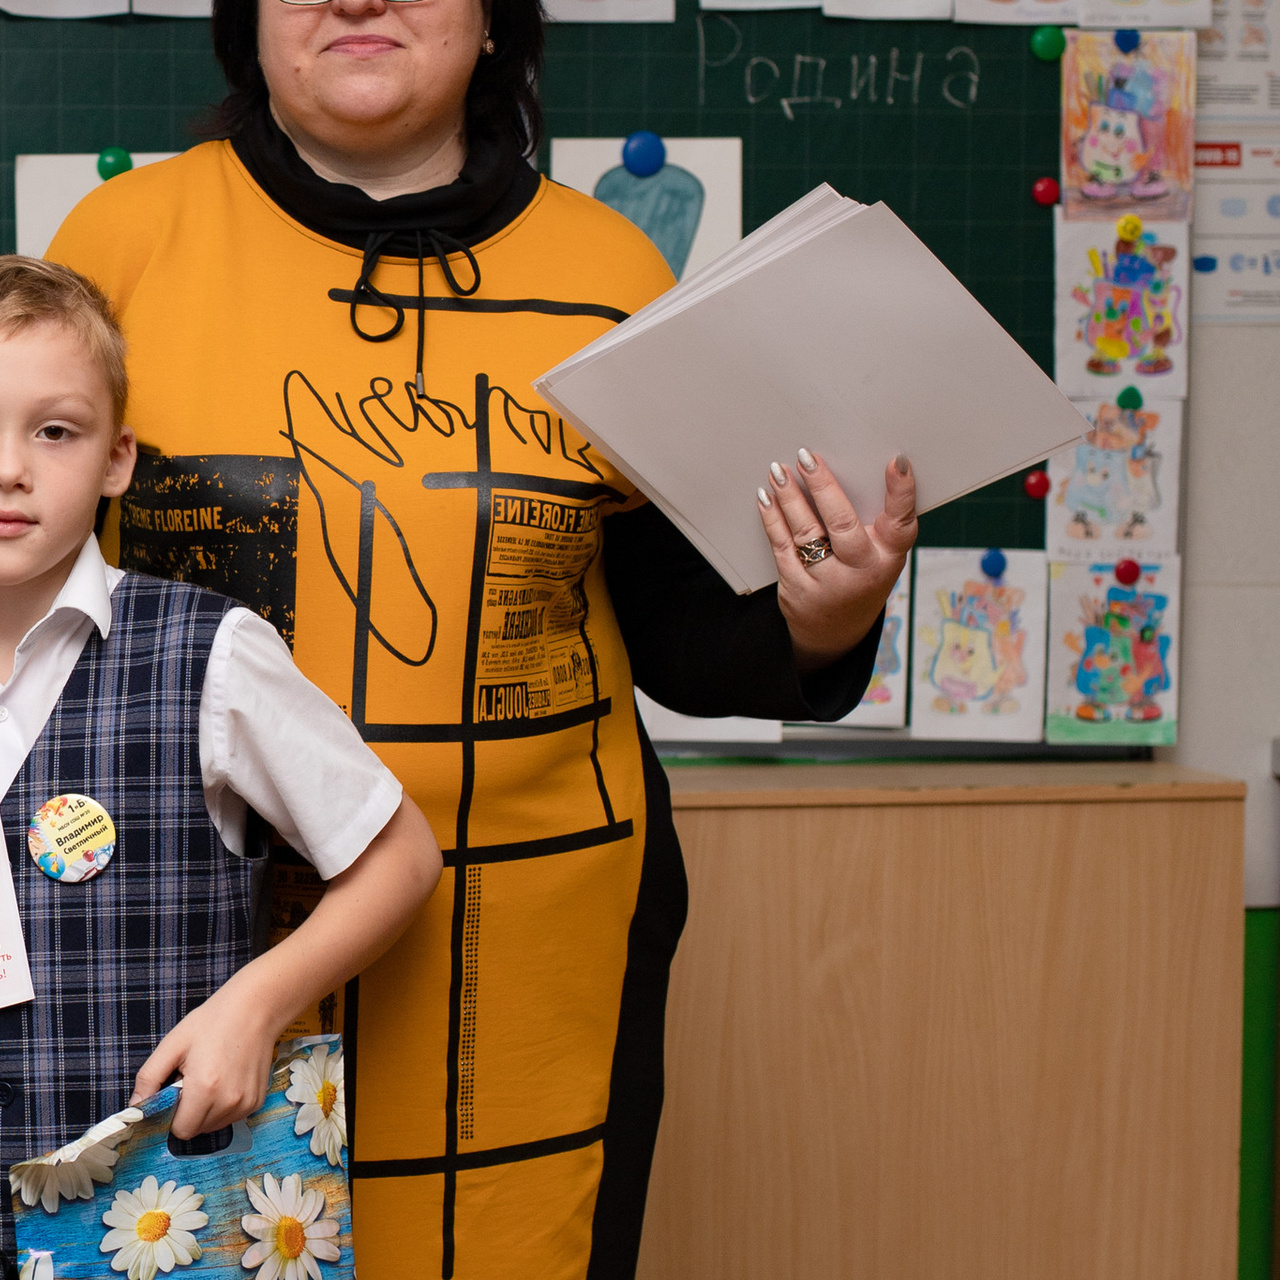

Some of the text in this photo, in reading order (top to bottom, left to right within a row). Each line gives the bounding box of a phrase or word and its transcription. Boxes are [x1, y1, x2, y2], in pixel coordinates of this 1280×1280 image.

[696, 12, 980, 120] Родина
[154, 506, 223, 532] FLOREINE
[55, 814, 104, 847] Владимир
[63, 824, 109, 855] Светличный
